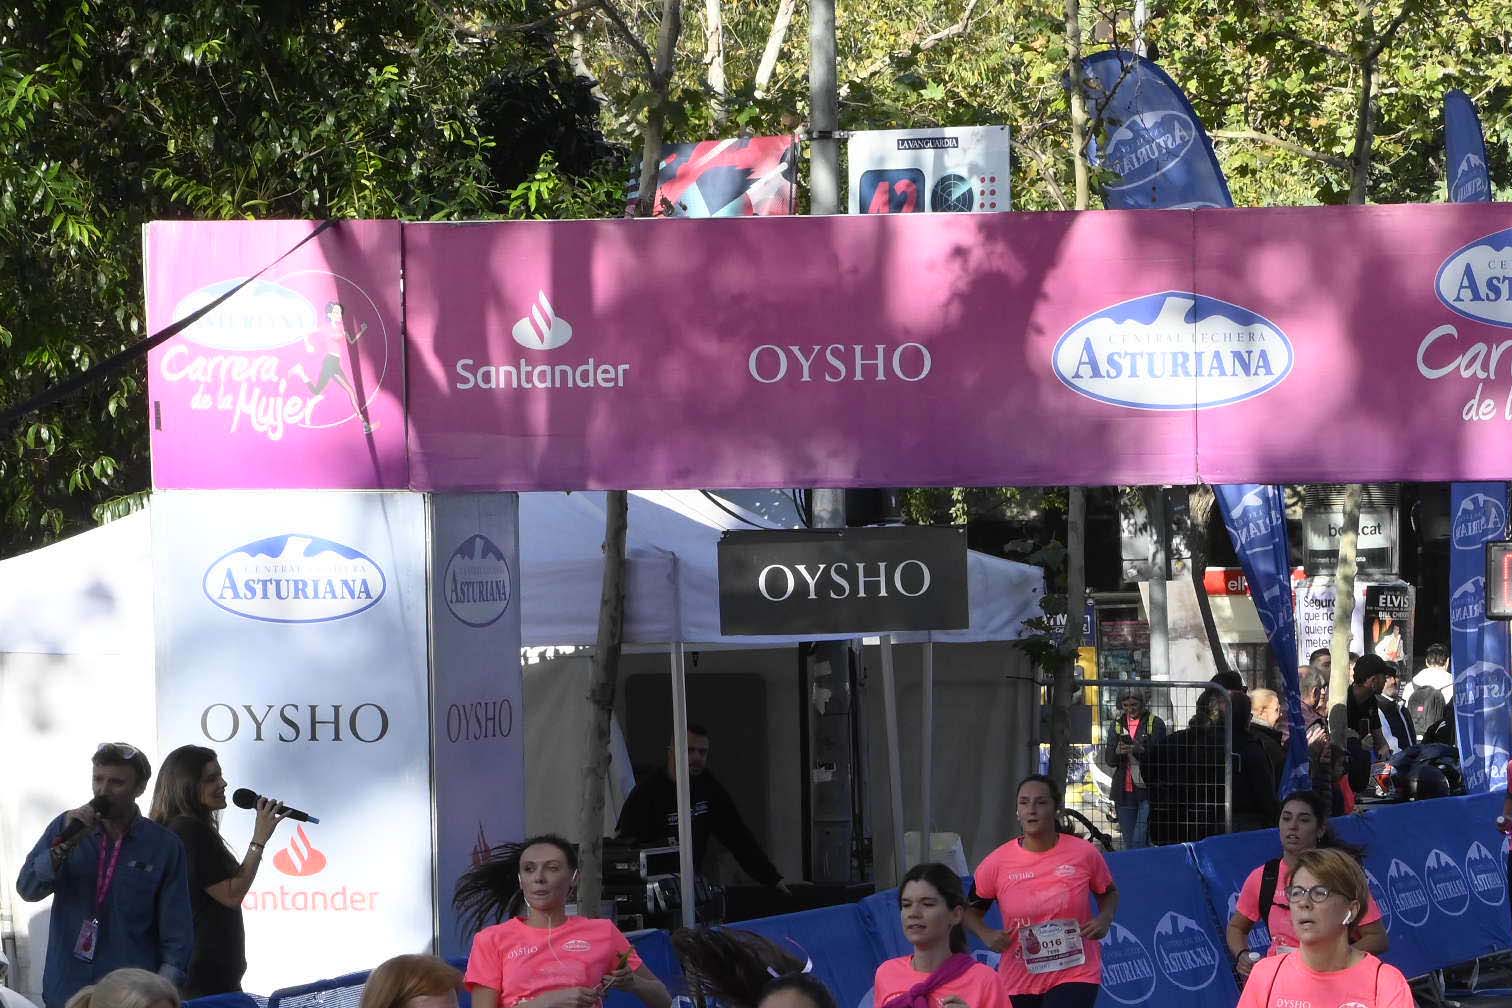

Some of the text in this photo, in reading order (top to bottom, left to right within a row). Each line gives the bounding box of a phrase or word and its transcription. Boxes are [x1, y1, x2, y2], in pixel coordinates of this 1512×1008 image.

[908, 137, 958, 148] VANGUARDIA
[160, 344, 280, 382] Carrera
[456, 357, 629, 390] Santander
[748, 343, 932, 383] OYSHO
[1071, 341, 1275, 380] ASTURIANA
[230, 378, 324, 440] Mujer
[1462, 385, 1496, 423] de
[218, 567, 373, 601] ASTURIANA
[449, 568, 507, 603] ASTURIANA
[757, 559, 931, 602] OYSHO
[1379, 595, 1409, 607] ELVIS
[200, 703, 389, 743] OYSHO
[446, 698, 513, 744] OYSHO
[241, 886, 379, 912] antander
[1041, 939, 1062, 949] 016
